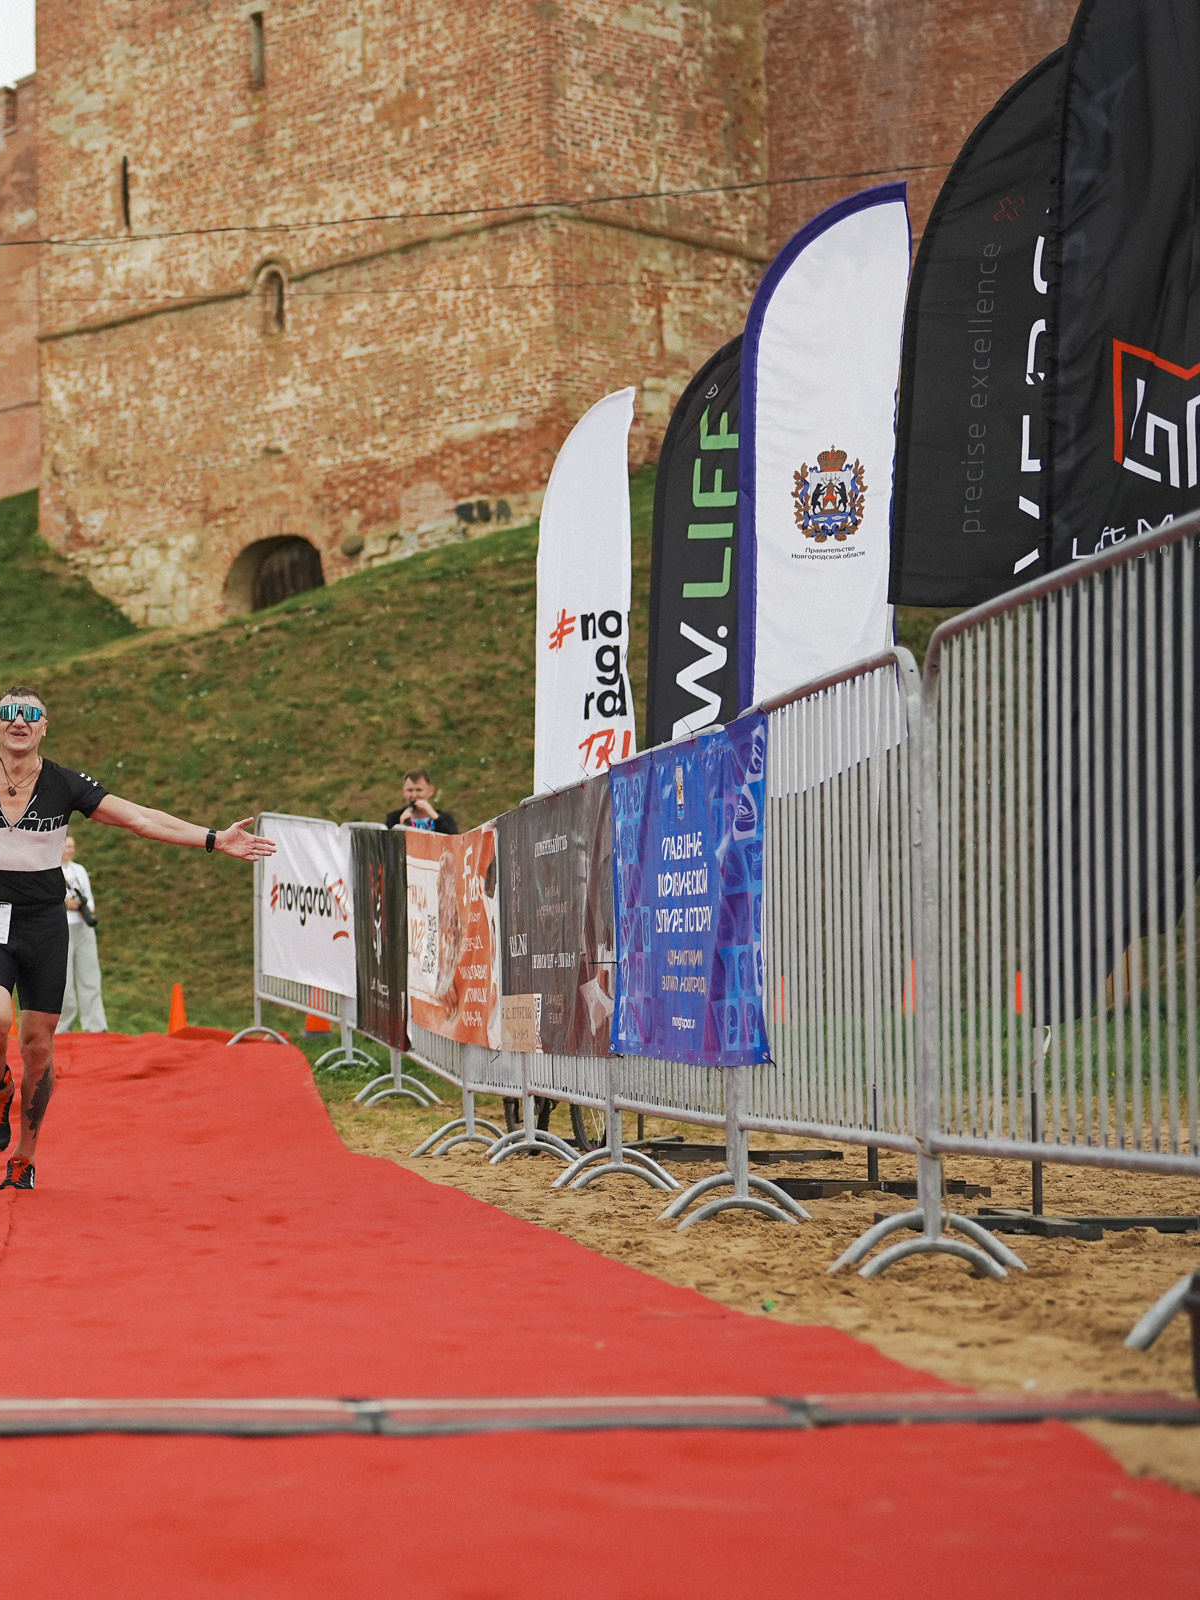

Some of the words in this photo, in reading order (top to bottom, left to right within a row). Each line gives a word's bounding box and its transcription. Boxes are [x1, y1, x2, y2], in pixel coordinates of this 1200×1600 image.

[967, 241, 1001, 409] excellence
[962, 422, 988, 534] precise
[805, 546, 856, 554] Правительство
[842, 550, 866, 559] области
[271, 873, 333, 927] #novgorod
